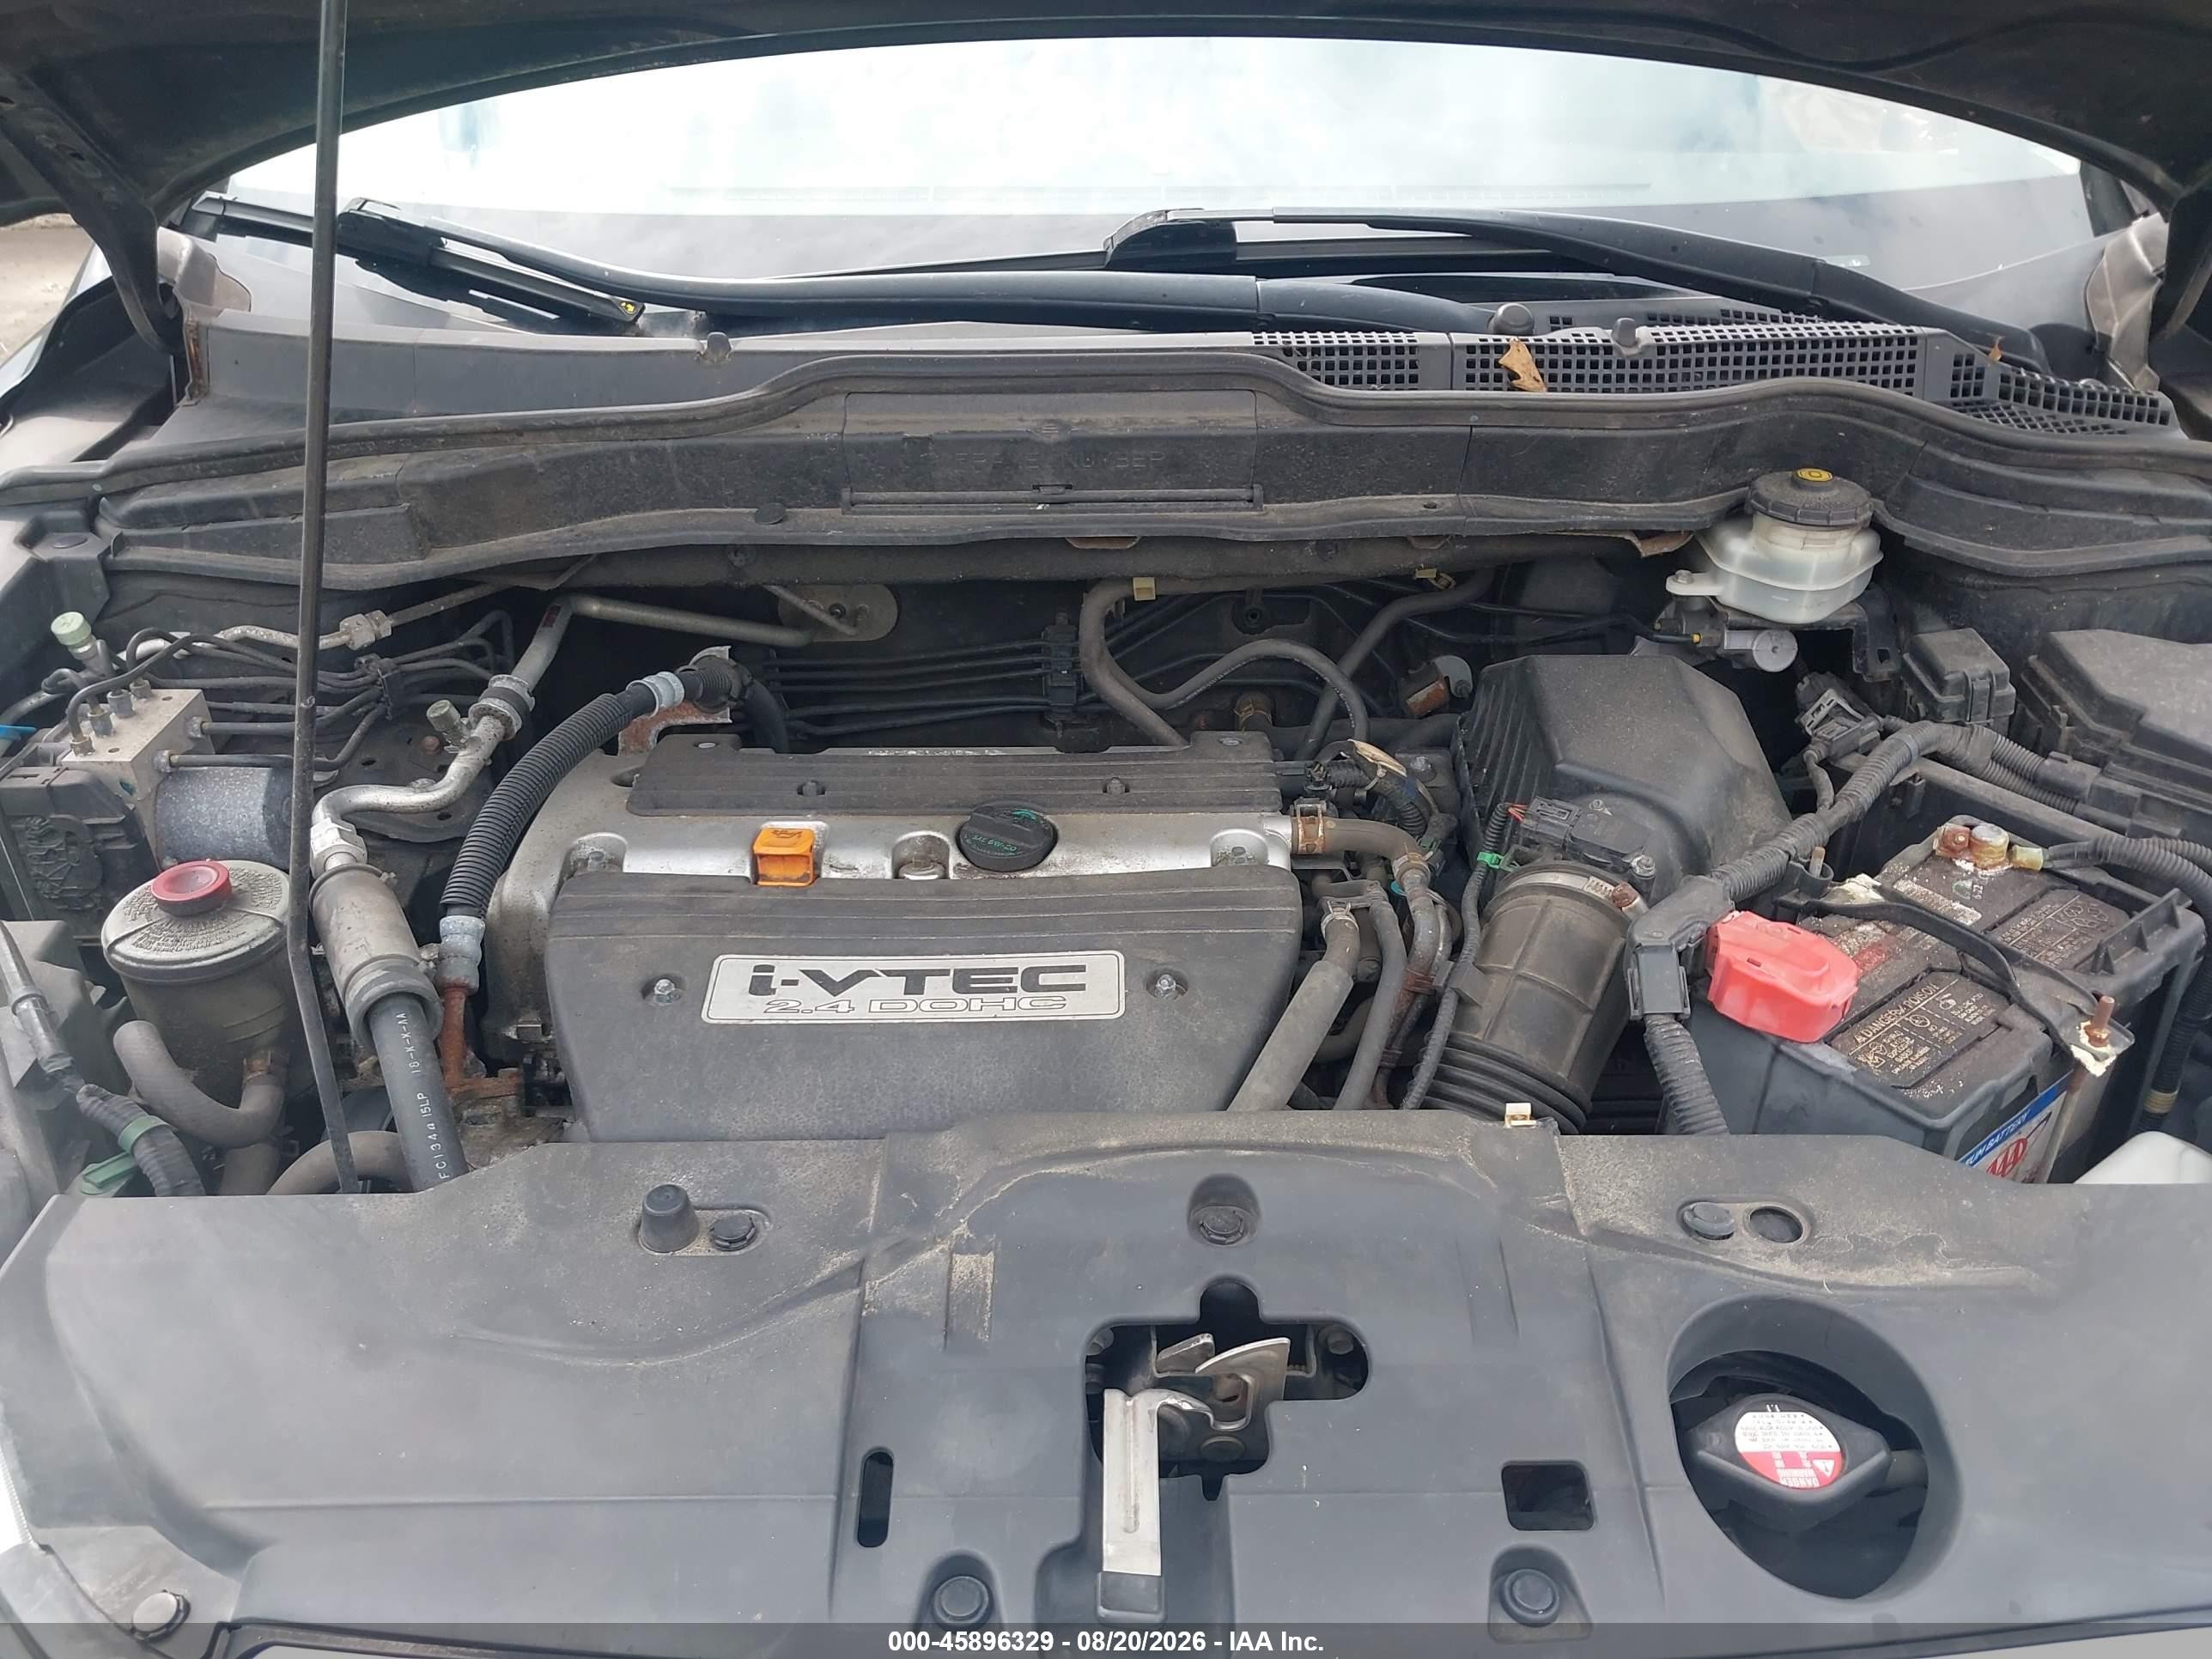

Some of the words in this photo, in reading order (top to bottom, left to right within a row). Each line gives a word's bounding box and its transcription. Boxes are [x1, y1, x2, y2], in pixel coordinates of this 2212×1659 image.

[955, 453, 1040, 469] FRAE
[764, 999, 855, 1015] 2.4
[867, 995, 1067, 1014] DOHC
[1863, 1007, 1900, 1039] DANGER
[1903, 983, 1941, 1009] POISON
[416, 1092, 433, 1117] 15LP
[1985, 1109, 2031, 1152] BATTERY
[426, 1122, 451, 1181] FC134a
[1780, 1476, 1820, 1488] DANGER
